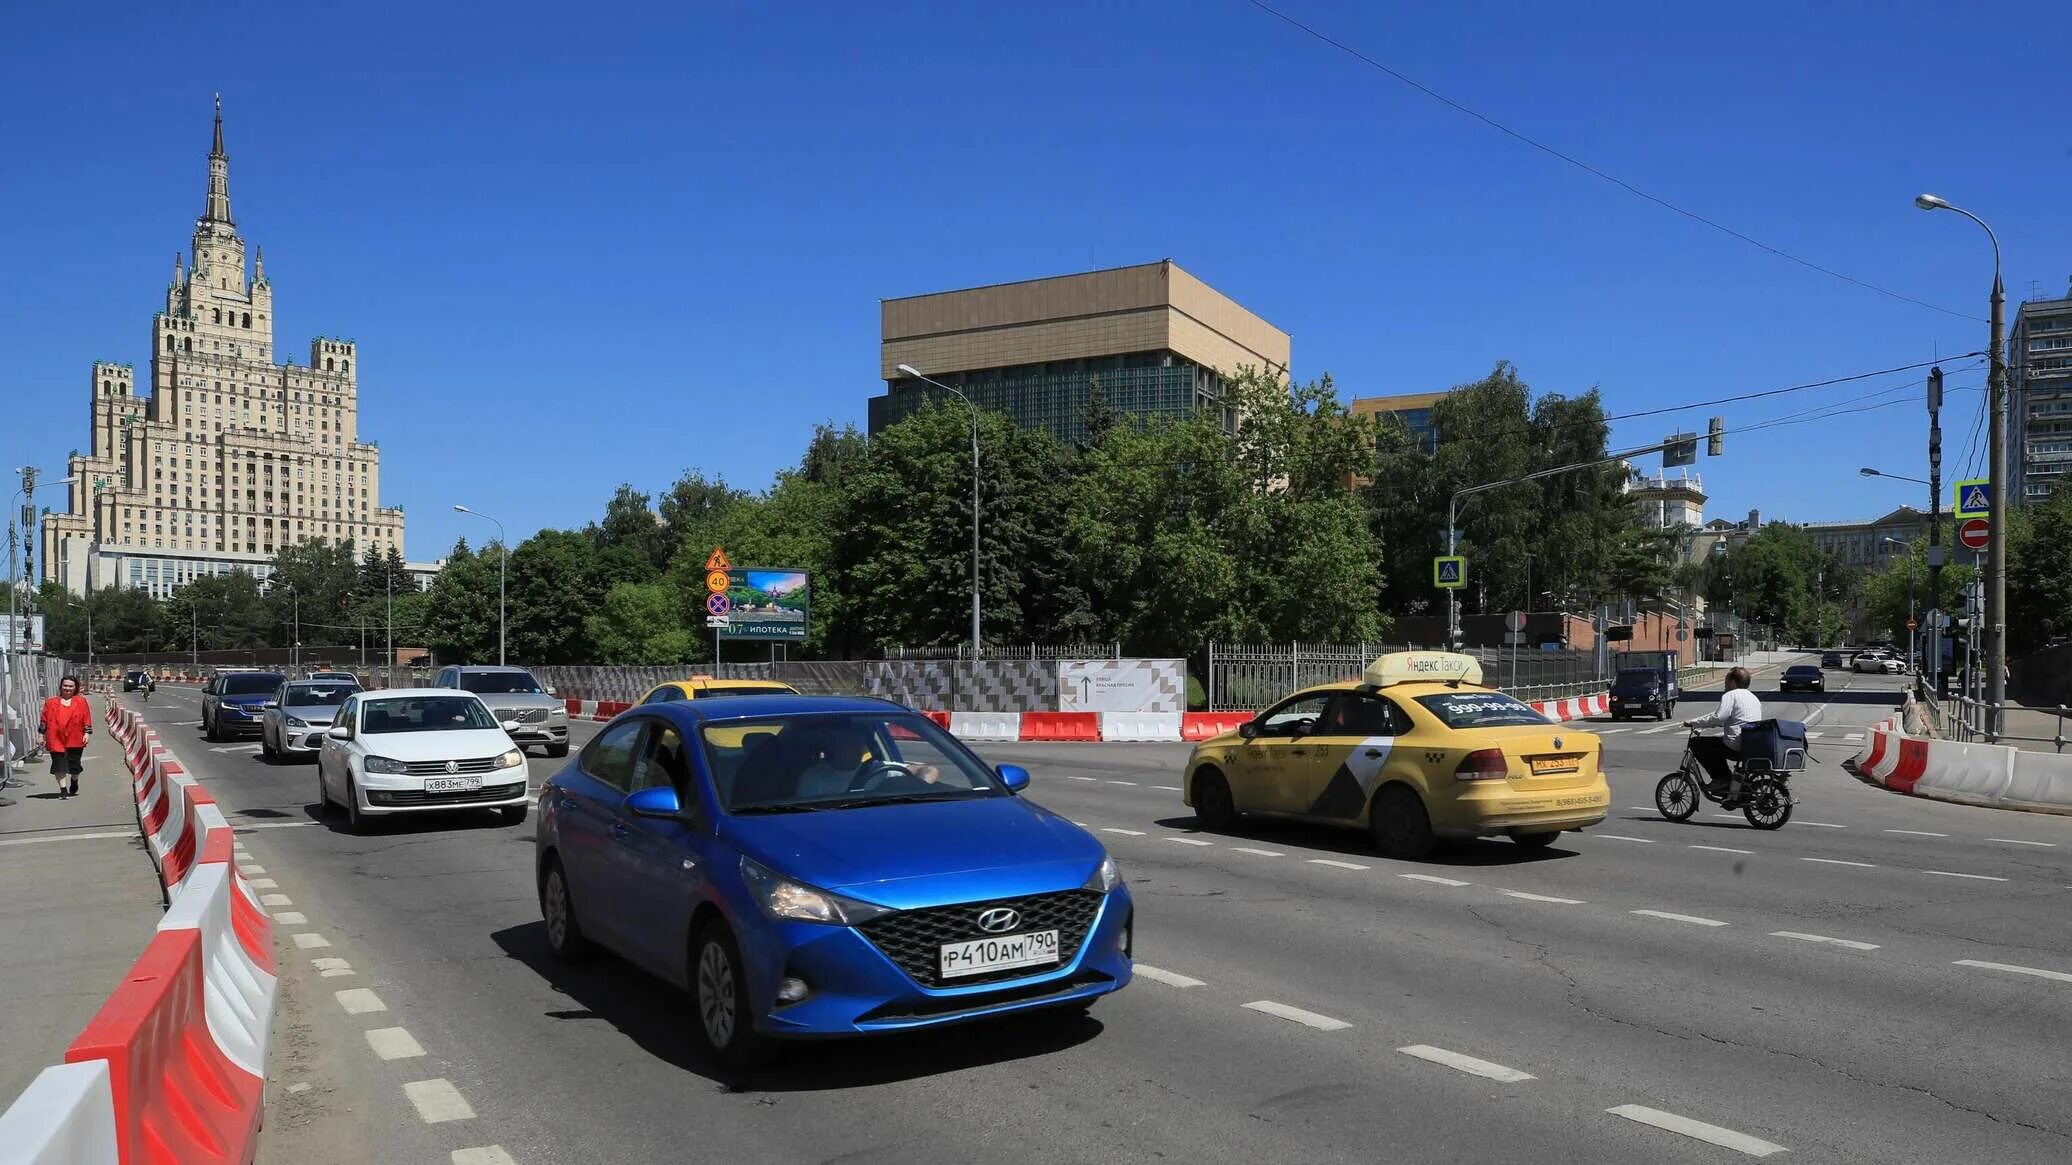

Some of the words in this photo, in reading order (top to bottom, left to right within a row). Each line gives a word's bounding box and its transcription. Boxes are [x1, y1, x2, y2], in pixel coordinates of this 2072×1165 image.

[712, 577, 725, 586] 40
[749, 626, 788, 634] ИПОТЕКА
[1407, 657, 1438, 672] Яндекс
[1440, 657, 1464, 671] Такси
[948, 942, 1024, 967] Р410АМ
[1027, 933, 1052, 950] 790
